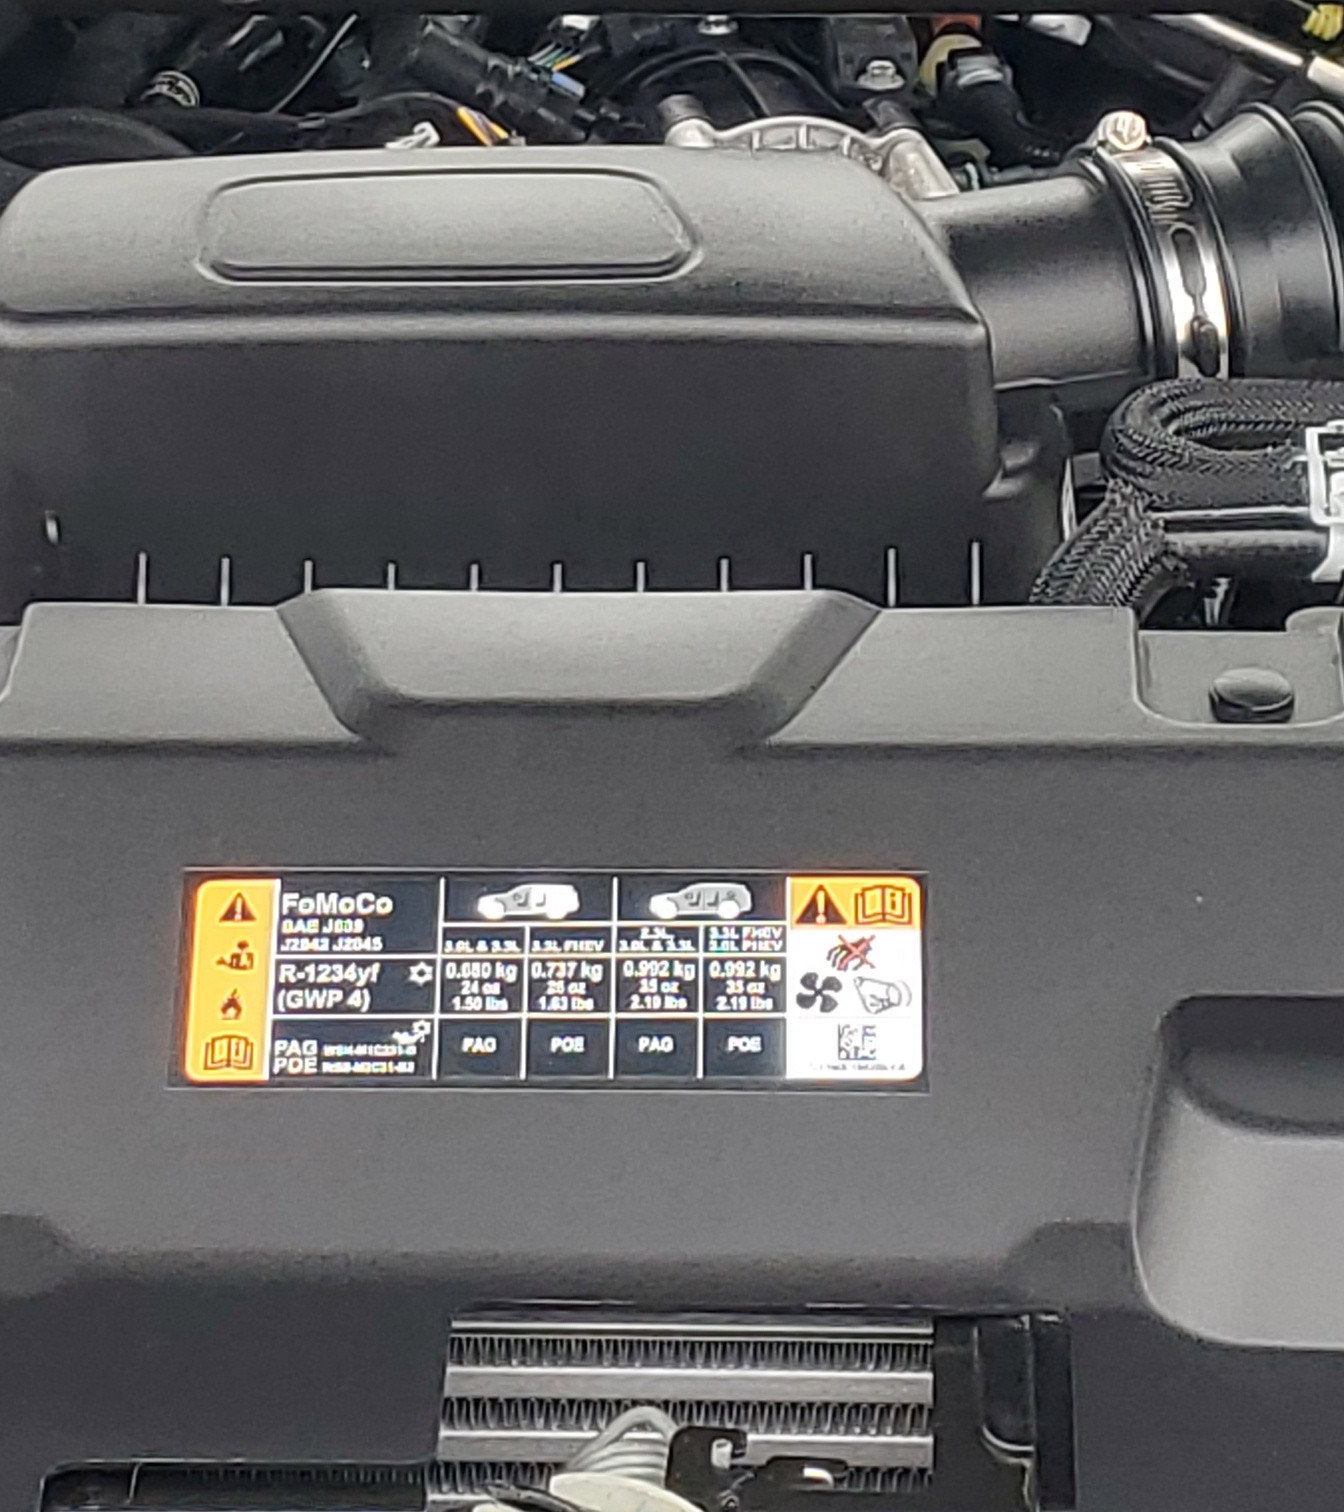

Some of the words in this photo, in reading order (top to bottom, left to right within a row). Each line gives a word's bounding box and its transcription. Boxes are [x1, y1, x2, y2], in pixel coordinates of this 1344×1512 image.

[281, 892, 394, 915] FoMoCo
[278, 963, 381, 987] R-1234yf
[494, 961, 518, 983] kg
[531, 961, 577, 979] 0.737
[580, 960, 604, 983] kg
[622, 960, 670, 978] 0.992
[672, 960, 696, 981] kg
[708, 960, 756, 978] 0.992
[759, 960, 781, 982] kg
[461, 981, 479, 994] 24
[482, 982, 501, 995] oz
[567, 982, 586, 994] oz
[660, 981, 680, 994] oz
[725, 979, 744, 994] 35
[746, 981, 766, 995] oz
[277, 988, 343, 1012] (GWP
[346, 988, 371, 1012] 4)
[451, 996, 482, 1010] 1.50
[485, 996, 509, 1011] lbs
[570, 996, 594, 1011] lbs
[664, 995, 688, 1009] lbs
[750, 995, 774, 1010] lbs
[274, 1040, 318, 1056] PAG
[461, 1037, 497, 1053] PAG
[550, 1036, 585, 1053] POE
[638, 1036, 674, 1053] PAG
[727, 1036, 762, 1053] POE
[273, 1057, 318, 1074] POE
